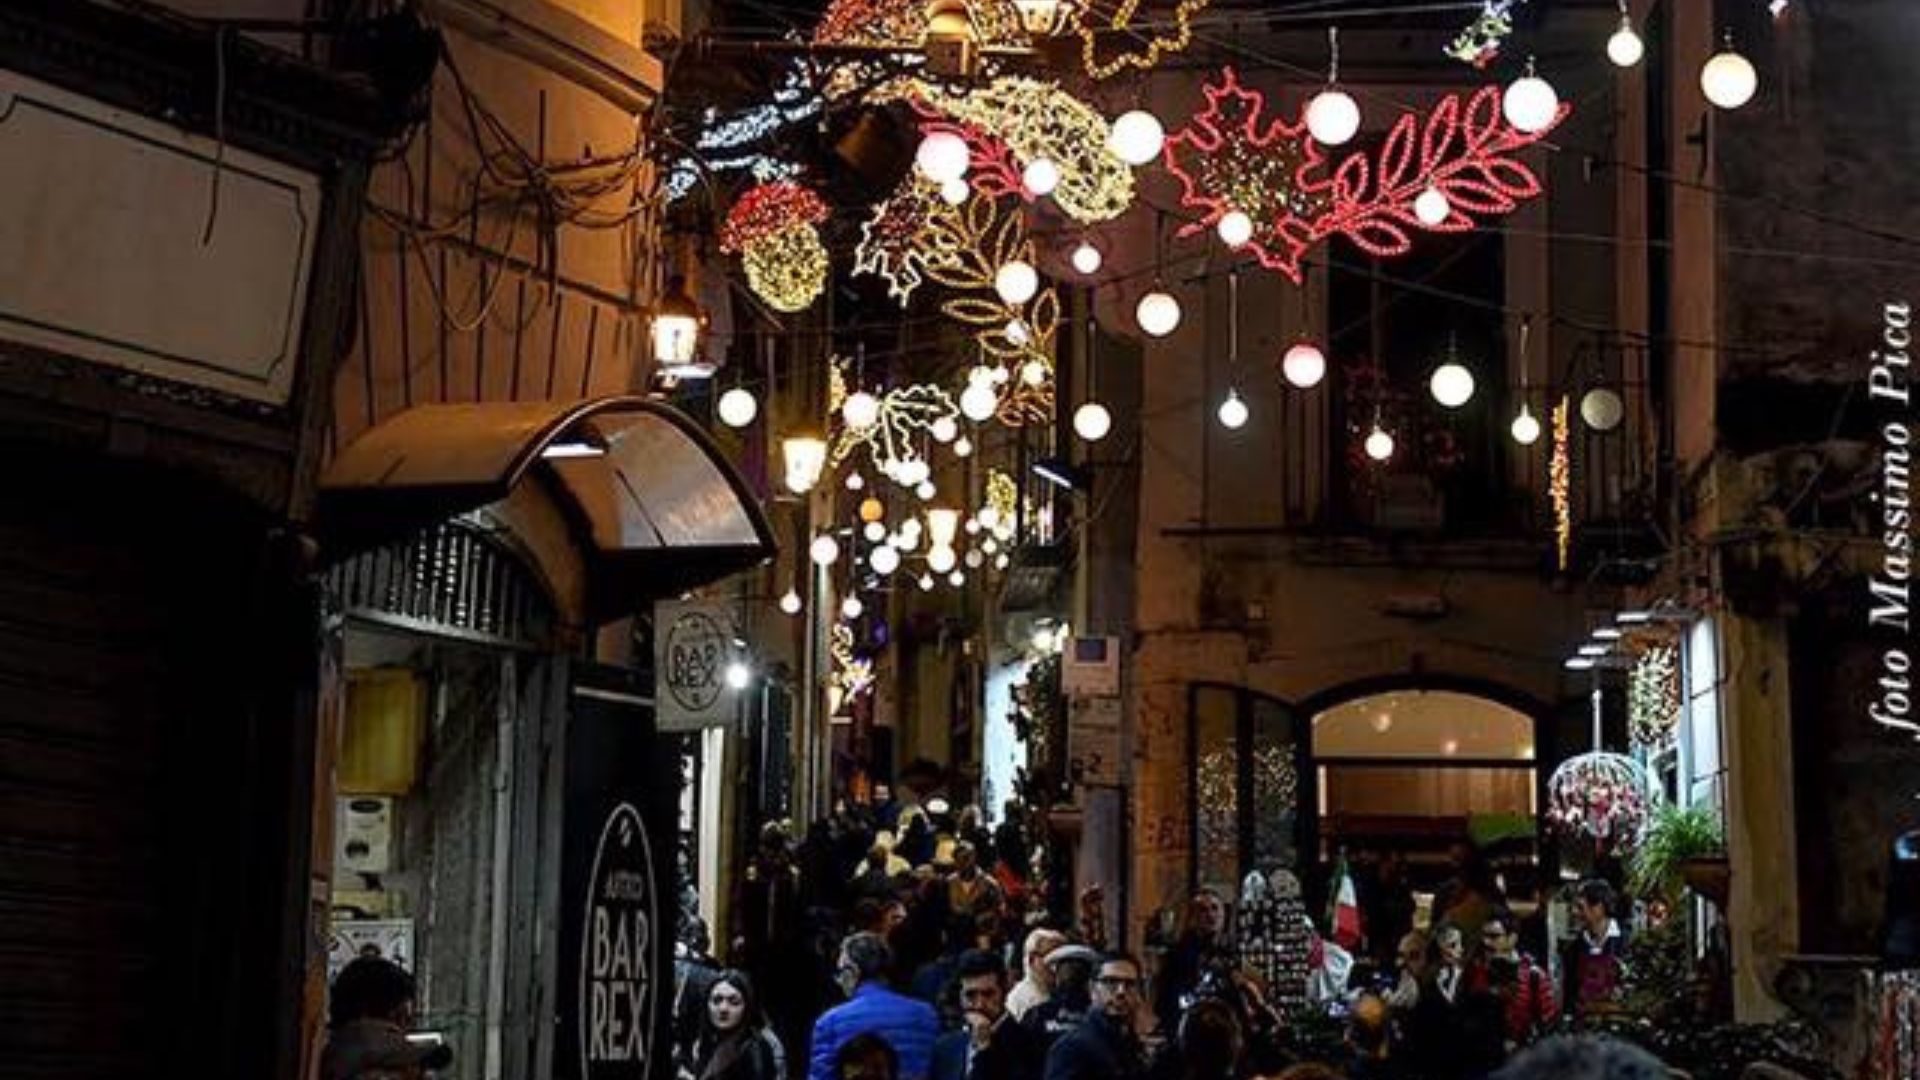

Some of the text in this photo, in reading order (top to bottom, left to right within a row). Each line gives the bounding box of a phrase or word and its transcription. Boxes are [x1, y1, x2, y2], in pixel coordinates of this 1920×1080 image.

[672, 664, 718, 688] REX
[673, 645, 718, 668] BAR
[592, 905, 649, 980] BAR
[590, 980, 649, 1061] REX
